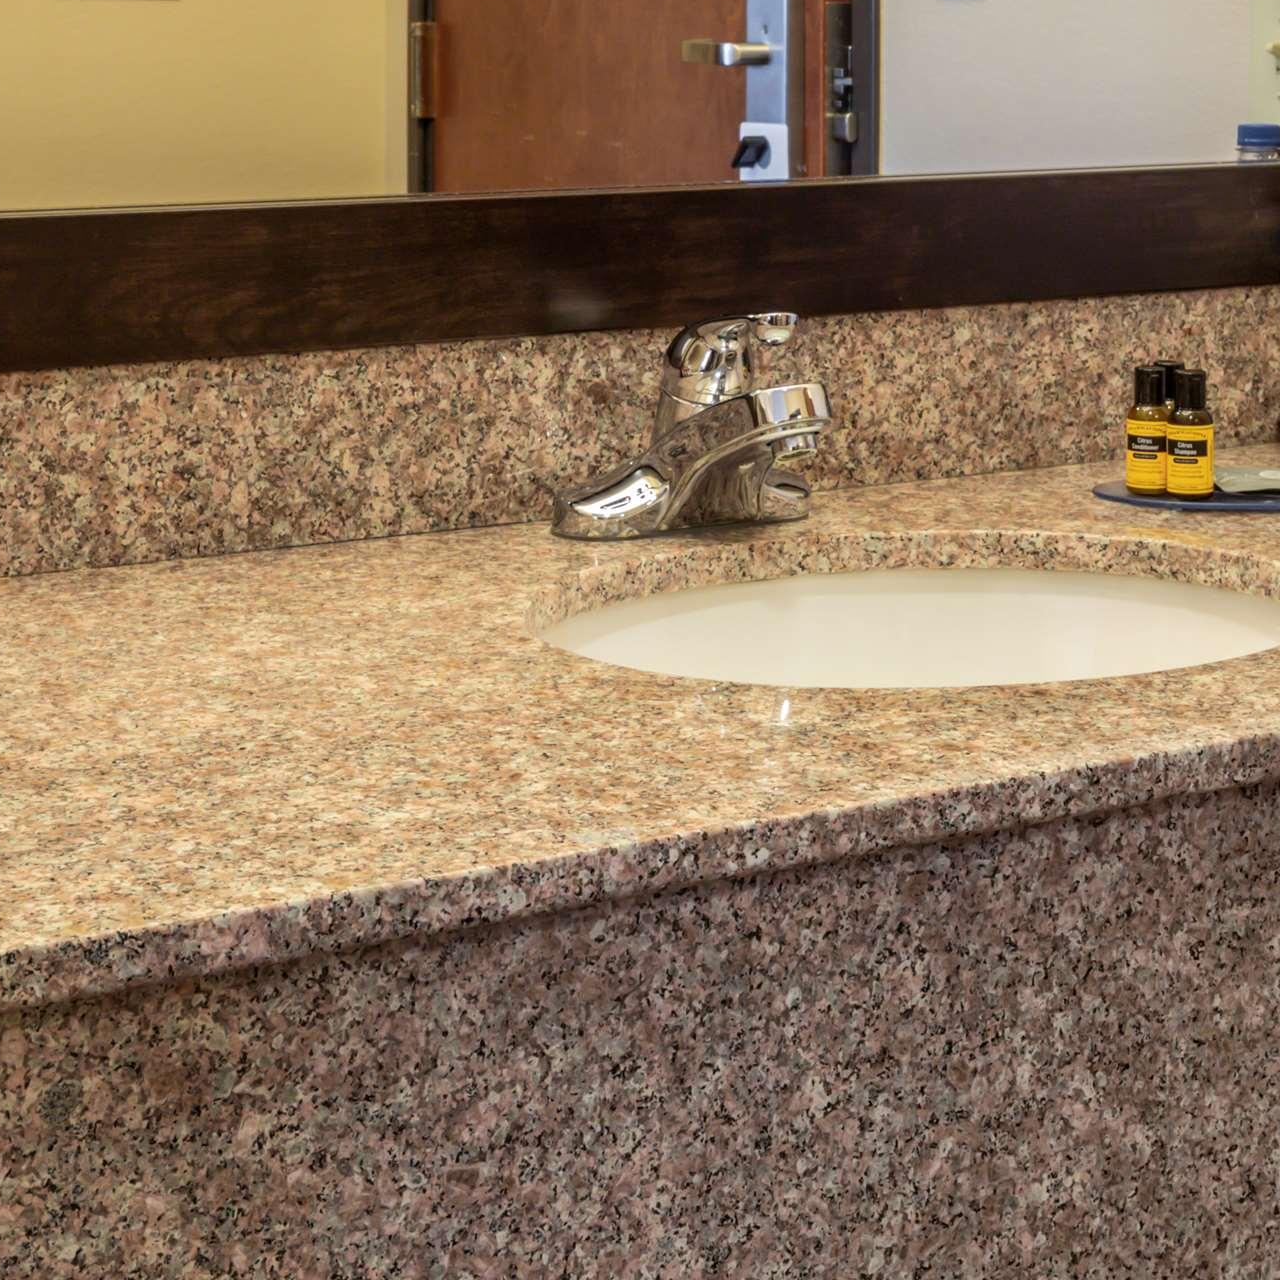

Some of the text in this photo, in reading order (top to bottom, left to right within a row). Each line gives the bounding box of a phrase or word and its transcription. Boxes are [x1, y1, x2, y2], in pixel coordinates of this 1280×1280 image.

[1137, 437, 1153, 445] Citrus
[1177, 441, 1193, 449] Citrus
[1131, 442, 1160, 451] Conditioner
[1174, 447, 1198, 456] Shampoo
